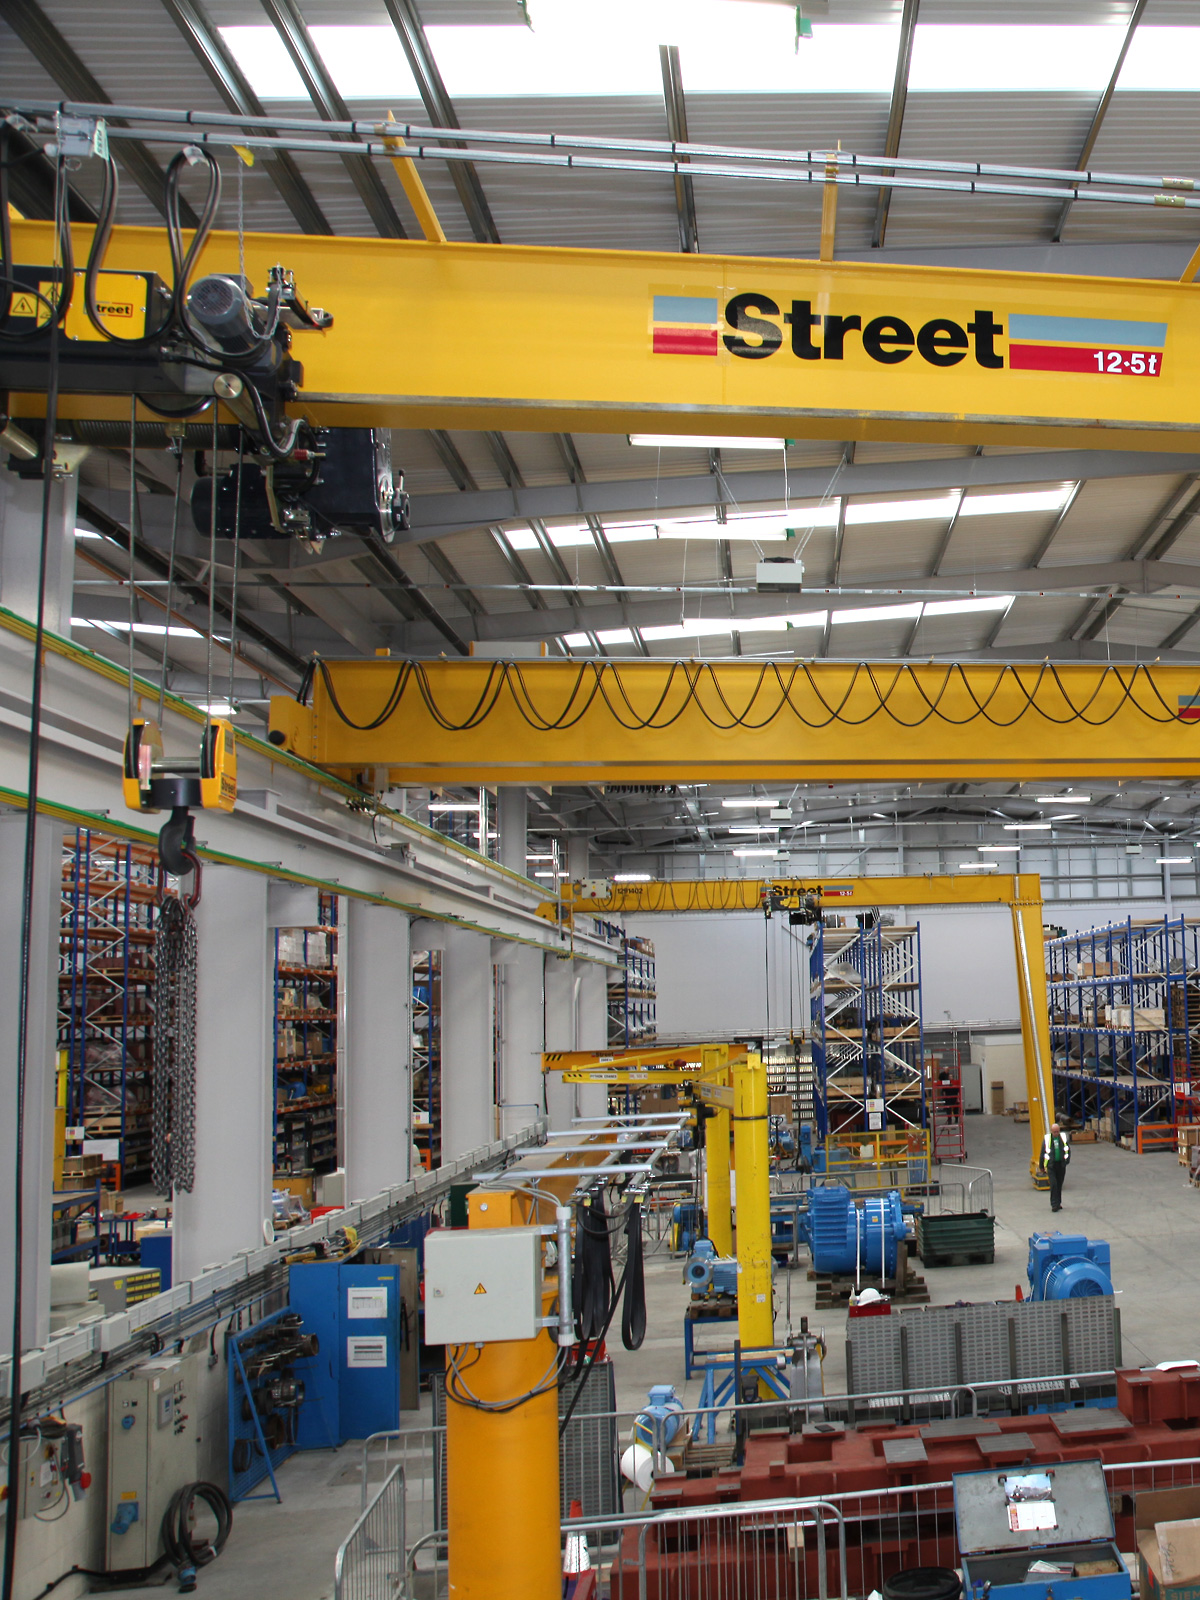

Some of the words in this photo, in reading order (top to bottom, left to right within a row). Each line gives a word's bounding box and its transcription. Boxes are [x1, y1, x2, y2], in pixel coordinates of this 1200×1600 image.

[95, 303, 130, 315] treet
[722, 292, 1004, 370] Street
[772, 885, 823, 897] Street
